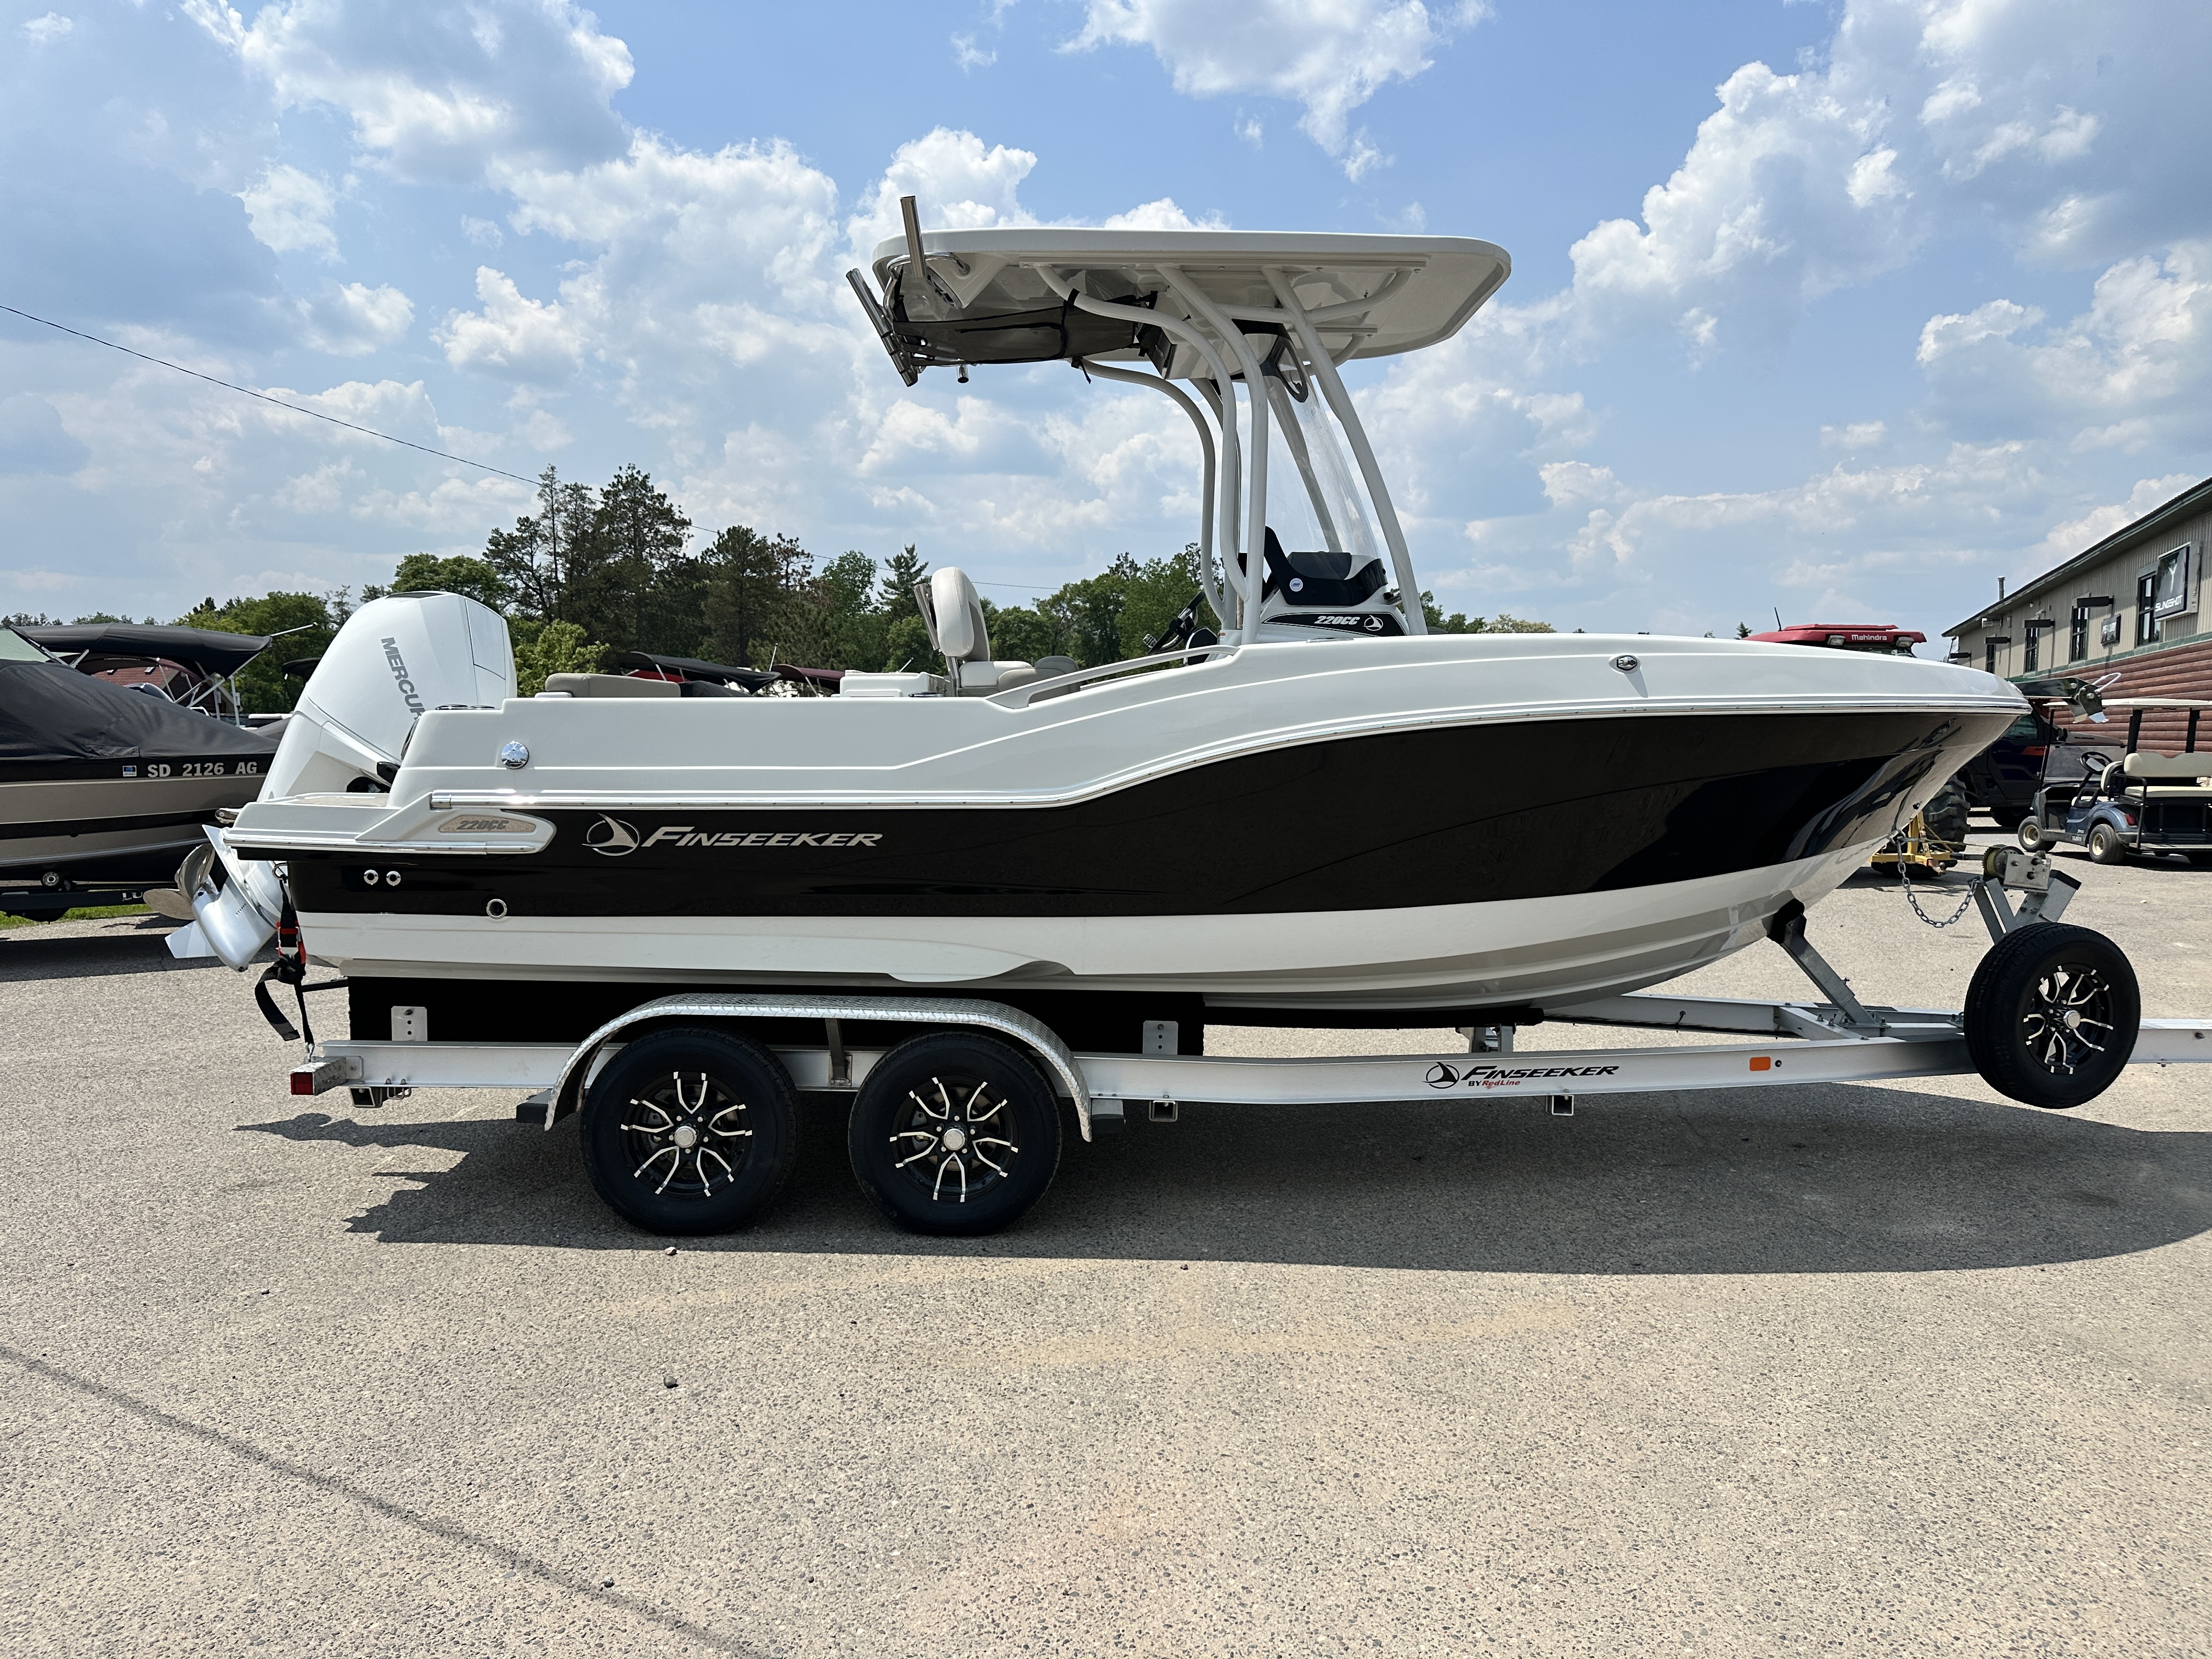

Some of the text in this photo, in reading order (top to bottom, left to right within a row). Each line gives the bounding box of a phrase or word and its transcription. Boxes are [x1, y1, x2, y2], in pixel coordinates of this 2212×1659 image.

[2155, 595, 2183, 612] SLINGSHOT
[1314, 616, 1361, 625] 220CC
[381, 637, 426, 720] MERCUR
[148, 761, 257, 778] SD 2126 AG
[456, 820, 509, 830] 220CC
[641, 826, 883, 847] FINSEEKER
[122, 892, 143, 901] LU
[1460, 1065, 1620, 1081] FINSEEKER
